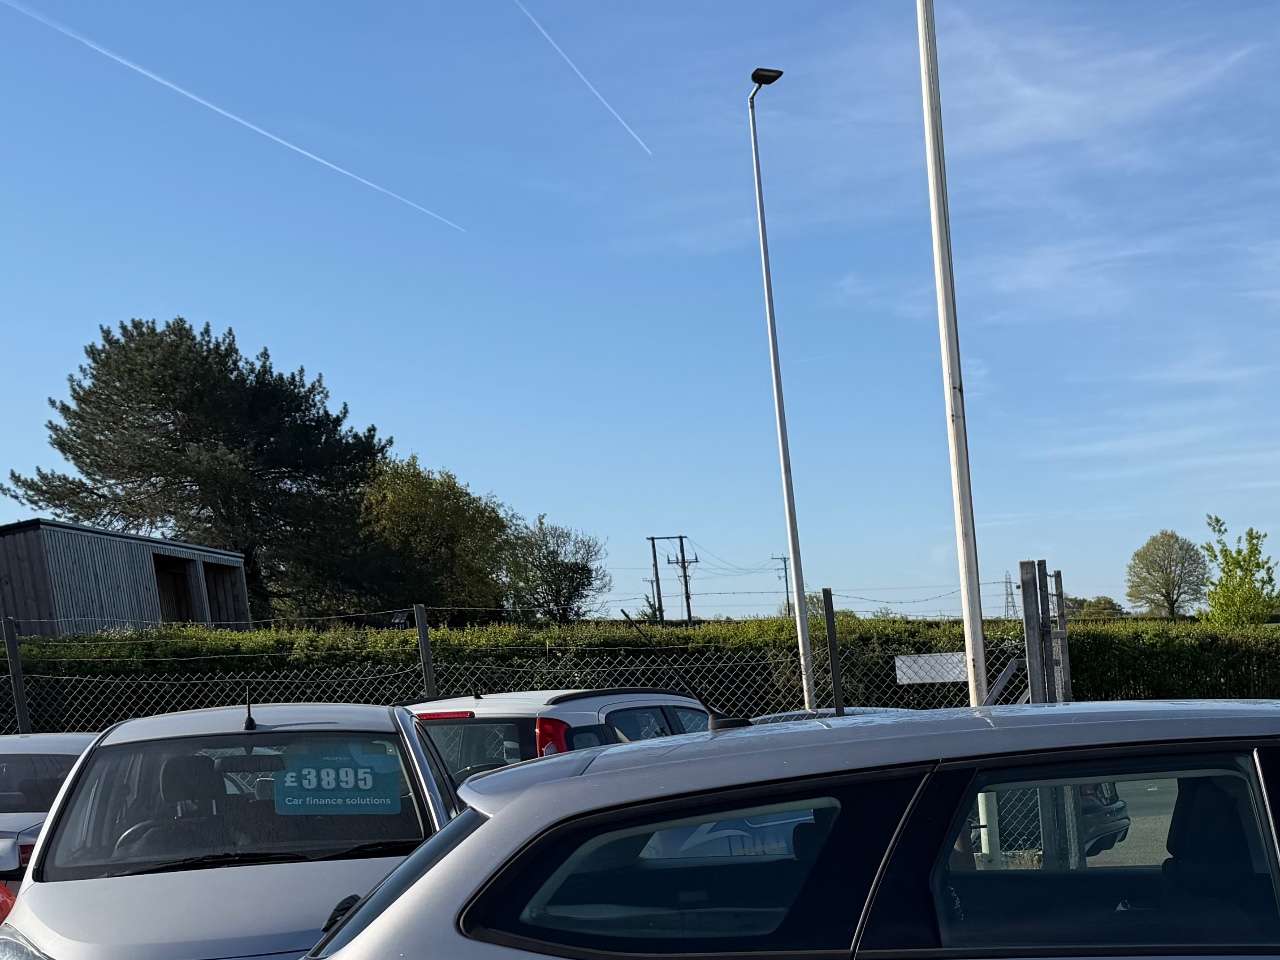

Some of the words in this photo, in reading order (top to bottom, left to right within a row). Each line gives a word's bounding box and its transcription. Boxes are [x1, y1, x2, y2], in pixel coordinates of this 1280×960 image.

[285, 796, 303, 806] Car
[305, 796, 343, 806] finance
[345, 796, 391, 805] solutions
